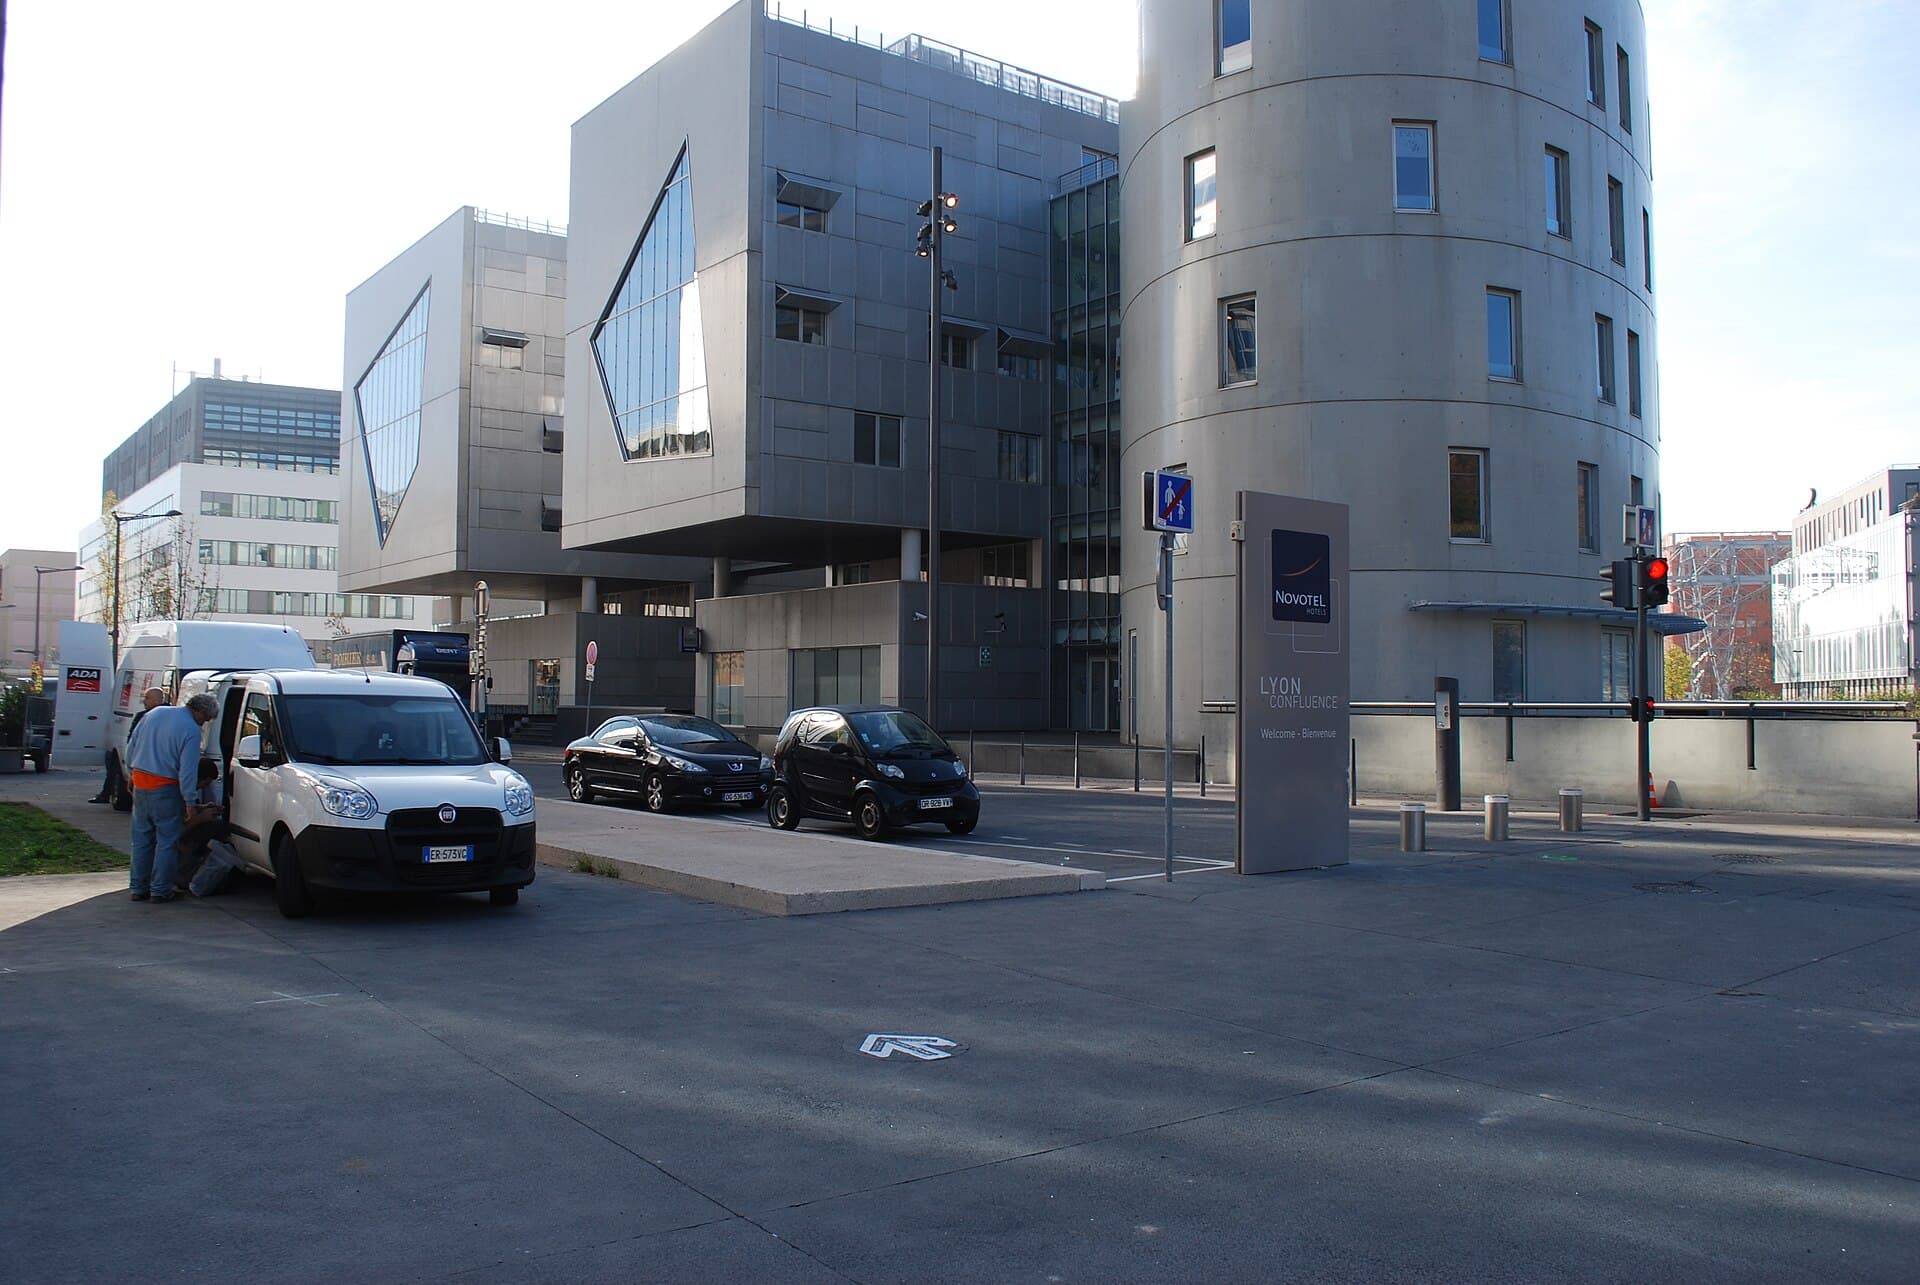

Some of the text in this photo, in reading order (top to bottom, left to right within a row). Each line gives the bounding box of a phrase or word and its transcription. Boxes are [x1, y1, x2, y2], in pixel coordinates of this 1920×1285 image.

[1275, 590, 1326, 607] NOVOTEL
[1306, 608, 1327, 616] HOTELS
[69, 669, 98, 679] ADA
[1260, 676, 1301, 695] LYON
[1269, 694, 1338, 709] CONFLUENCE
[1260, 727, 1296, 739] Welcome
[1302, 727, 1337, 738] Bienvenue
